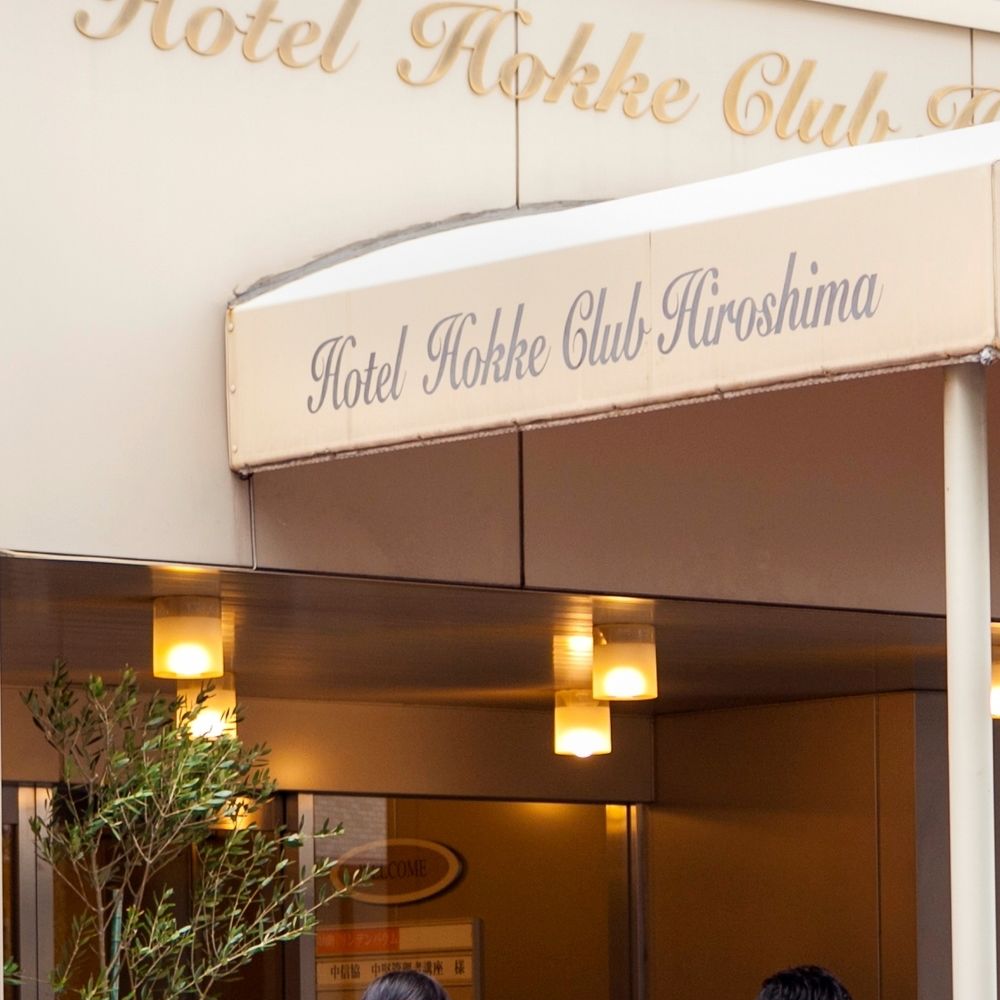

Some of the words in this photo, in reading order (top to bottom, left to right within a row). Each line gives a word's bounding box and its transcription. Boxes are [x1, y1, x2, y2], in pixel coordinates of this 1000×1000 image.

[396, 0, 700, 125] Hokke
[722, 50, 901, 147] Club
[306, 324, 409, 415] Hotel
[422, 303, 551, 396] Hokke
[562, 281, 653, 370] Club
[657, 251, 884, 355] Hiroshima
